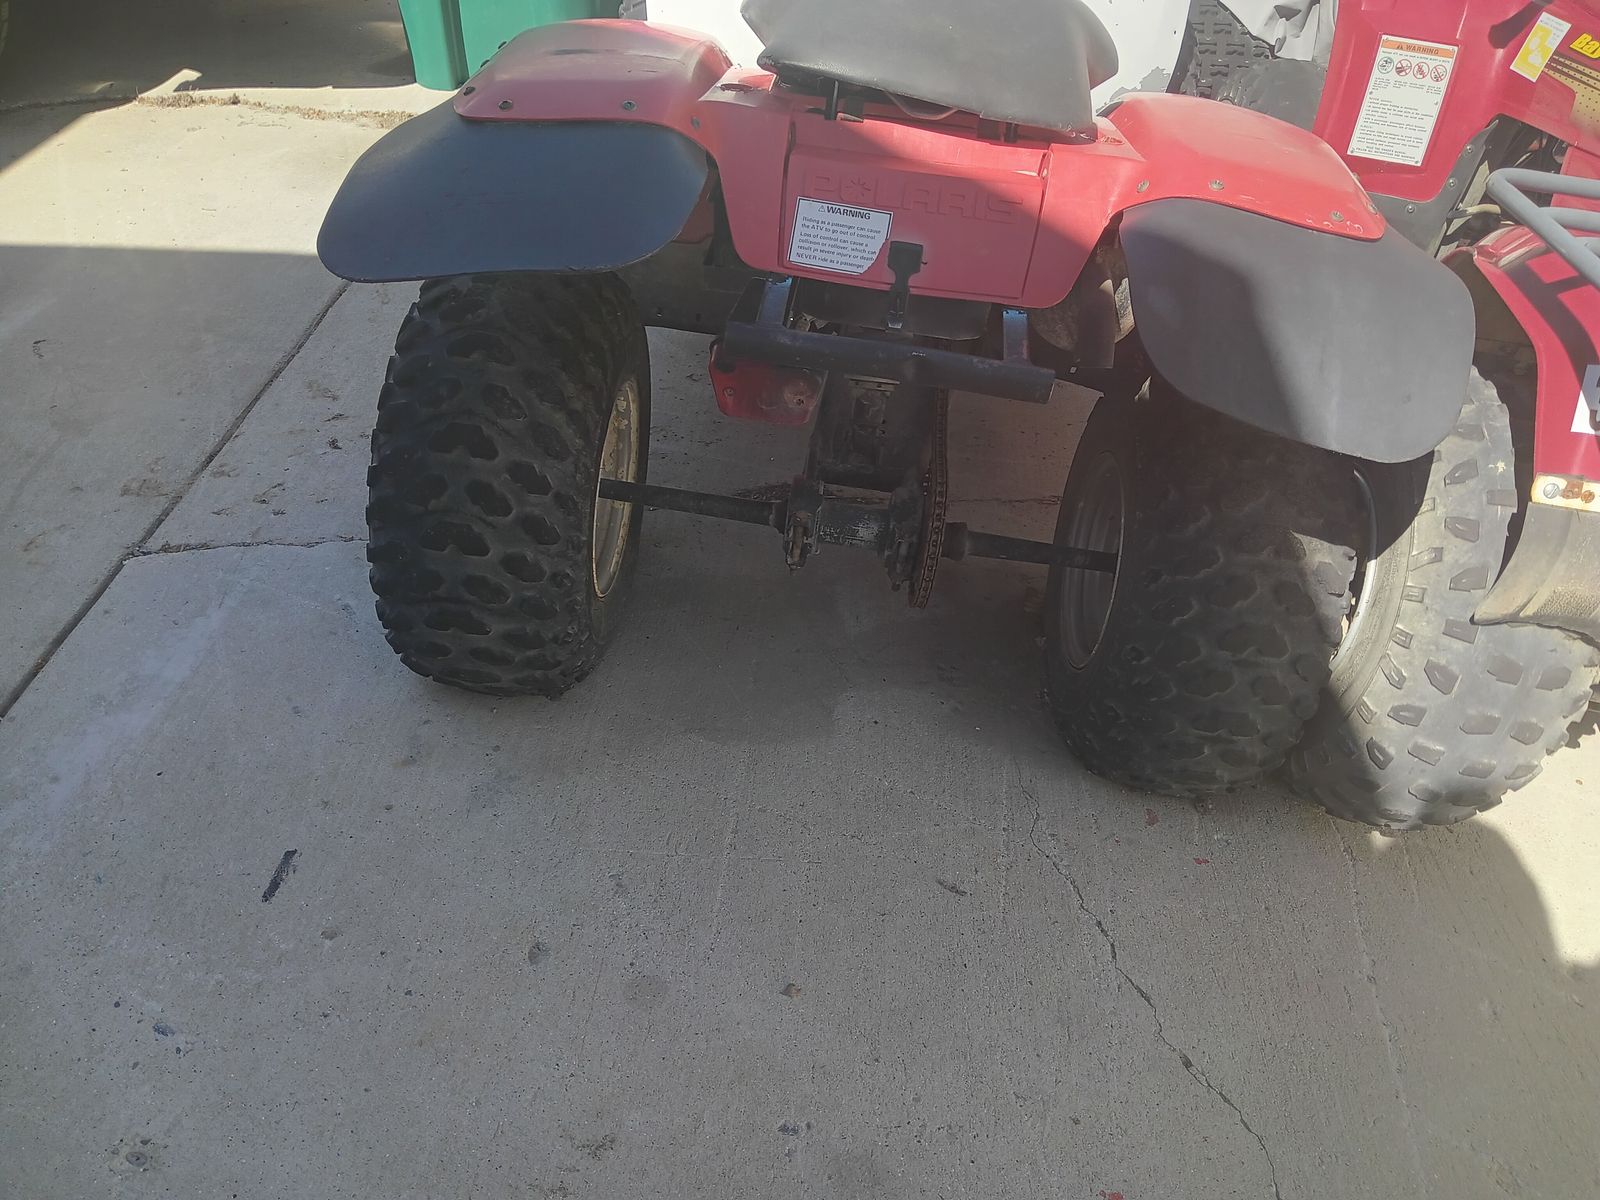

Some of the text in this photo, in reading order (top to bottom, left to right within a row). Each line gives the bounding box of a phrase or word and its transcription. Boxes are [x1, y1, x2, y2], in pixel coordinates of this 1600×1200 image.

[1406, 45, 1439, 55] WARNING
[826, 206, 871, 220] WARNING
[802, 216, 820, 224] Riding
[831, 221, 855, 230] passenger
[828, 242, 849, 251] rollover,
[796, 252, 816, 260] NEVER
